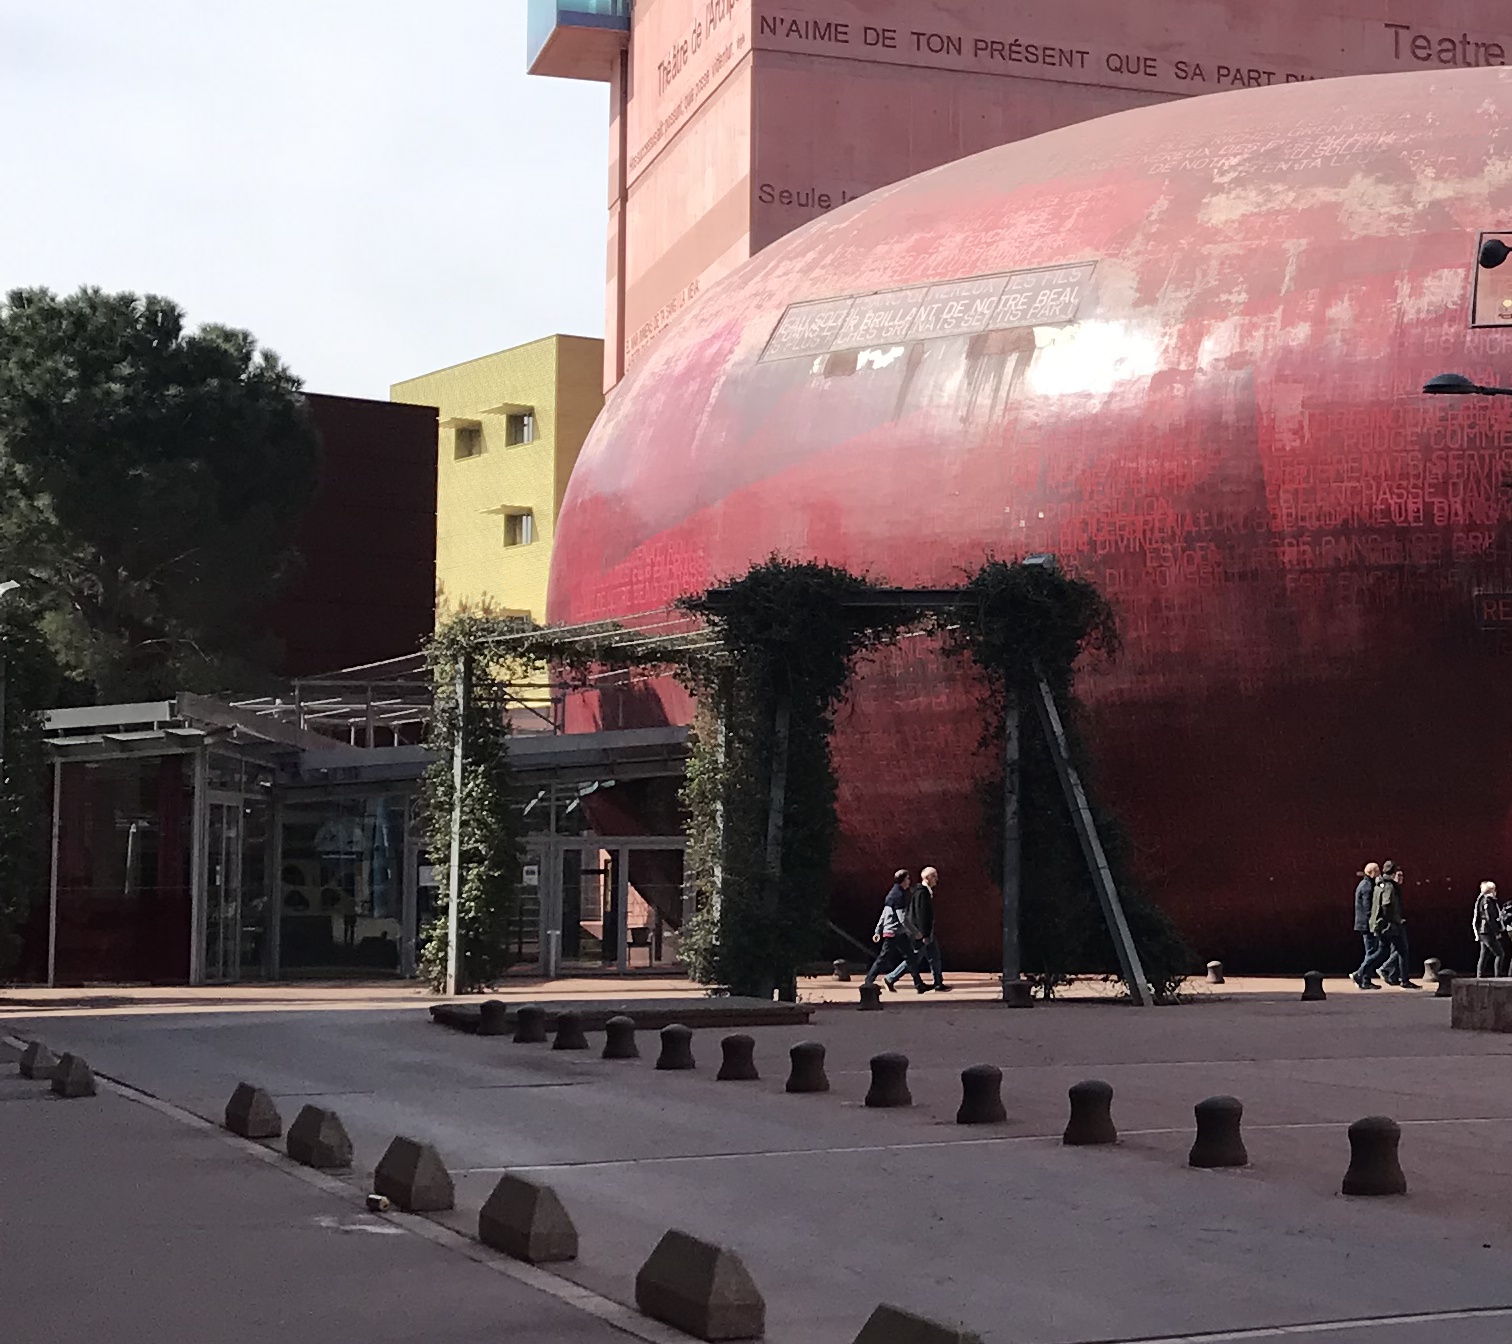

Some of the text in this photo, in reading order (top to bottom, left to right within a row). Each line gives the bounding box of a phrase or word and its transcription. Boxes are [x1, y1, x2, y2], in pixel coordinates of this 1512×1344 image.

[760, 15, 849, 44] N'AIME
[864, 27, 898, 49] DE
[911, 31, 963, 56] TON
[973, 38, 1089, 70] PRÉSENT
[1106, 53, 1157, 77] QUE
[1174, 60, 1206, 82] SA
[1217, 65, 1276, 87] PART
[1384, 23, 1506, 67] Teatre
[759, 183, 831, 209] Seule
